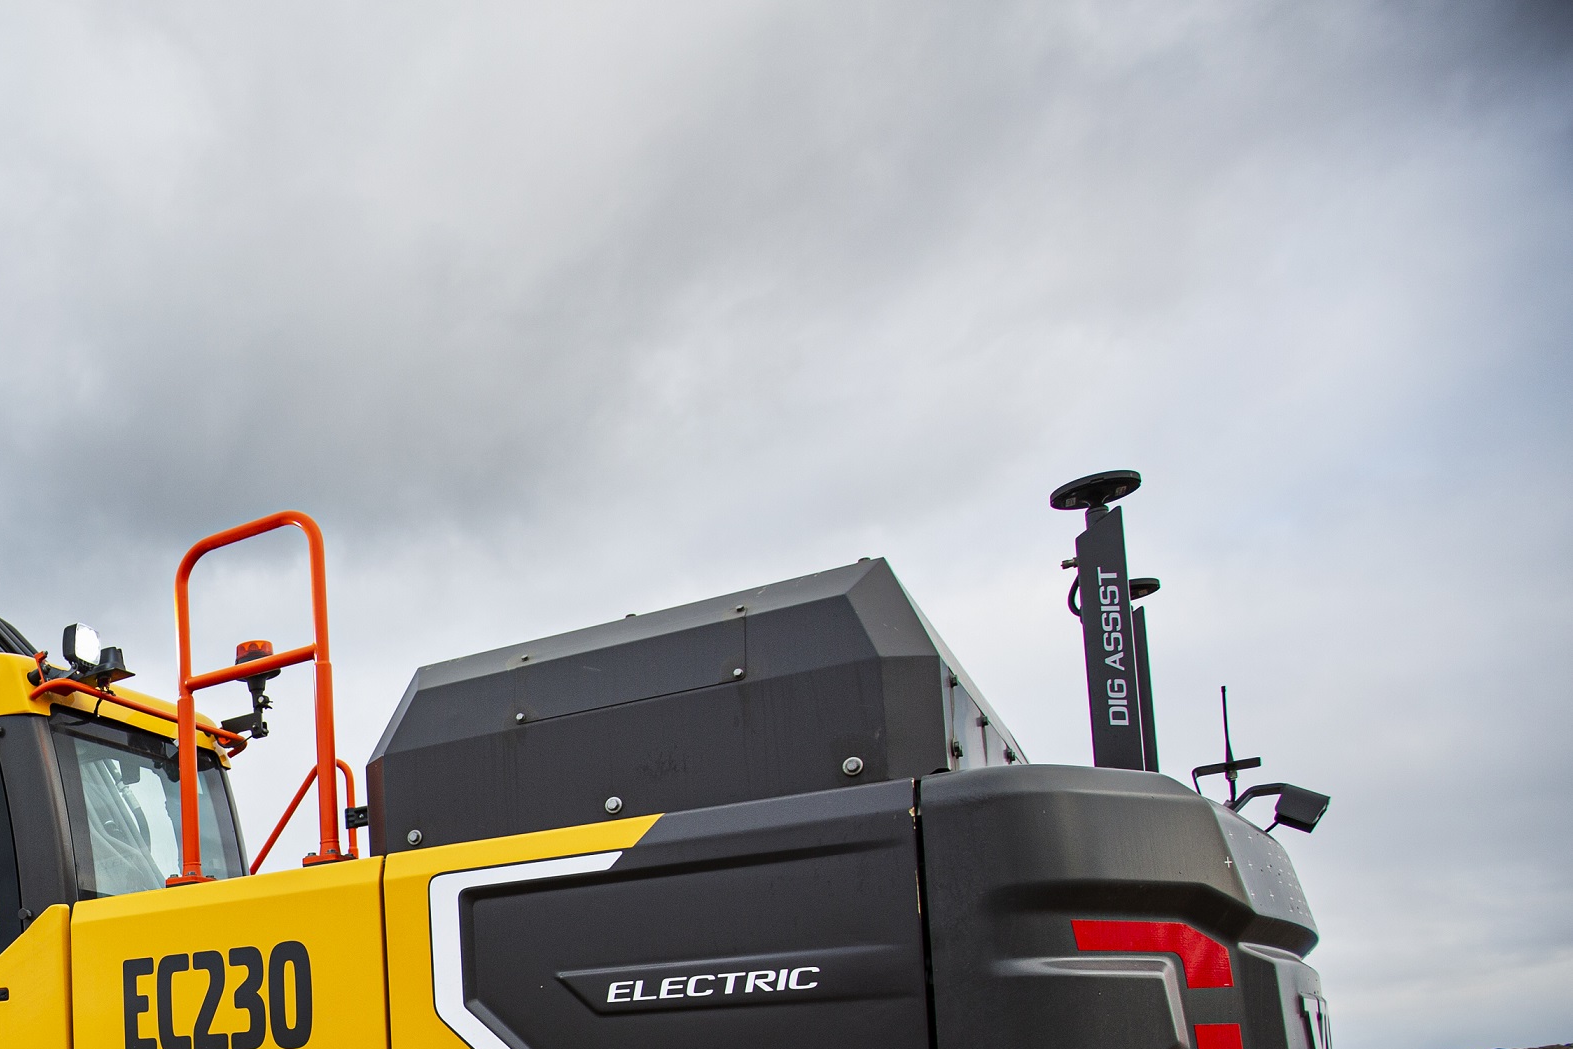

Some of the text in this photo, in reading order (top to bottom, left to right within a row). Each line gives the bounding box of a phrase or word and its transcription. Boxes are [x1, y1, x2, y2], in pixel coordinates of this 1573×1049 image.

[1096, 566, 1130, 727] DIG ASSIST
[606, 966, 821, 1003] ELECTRIC
